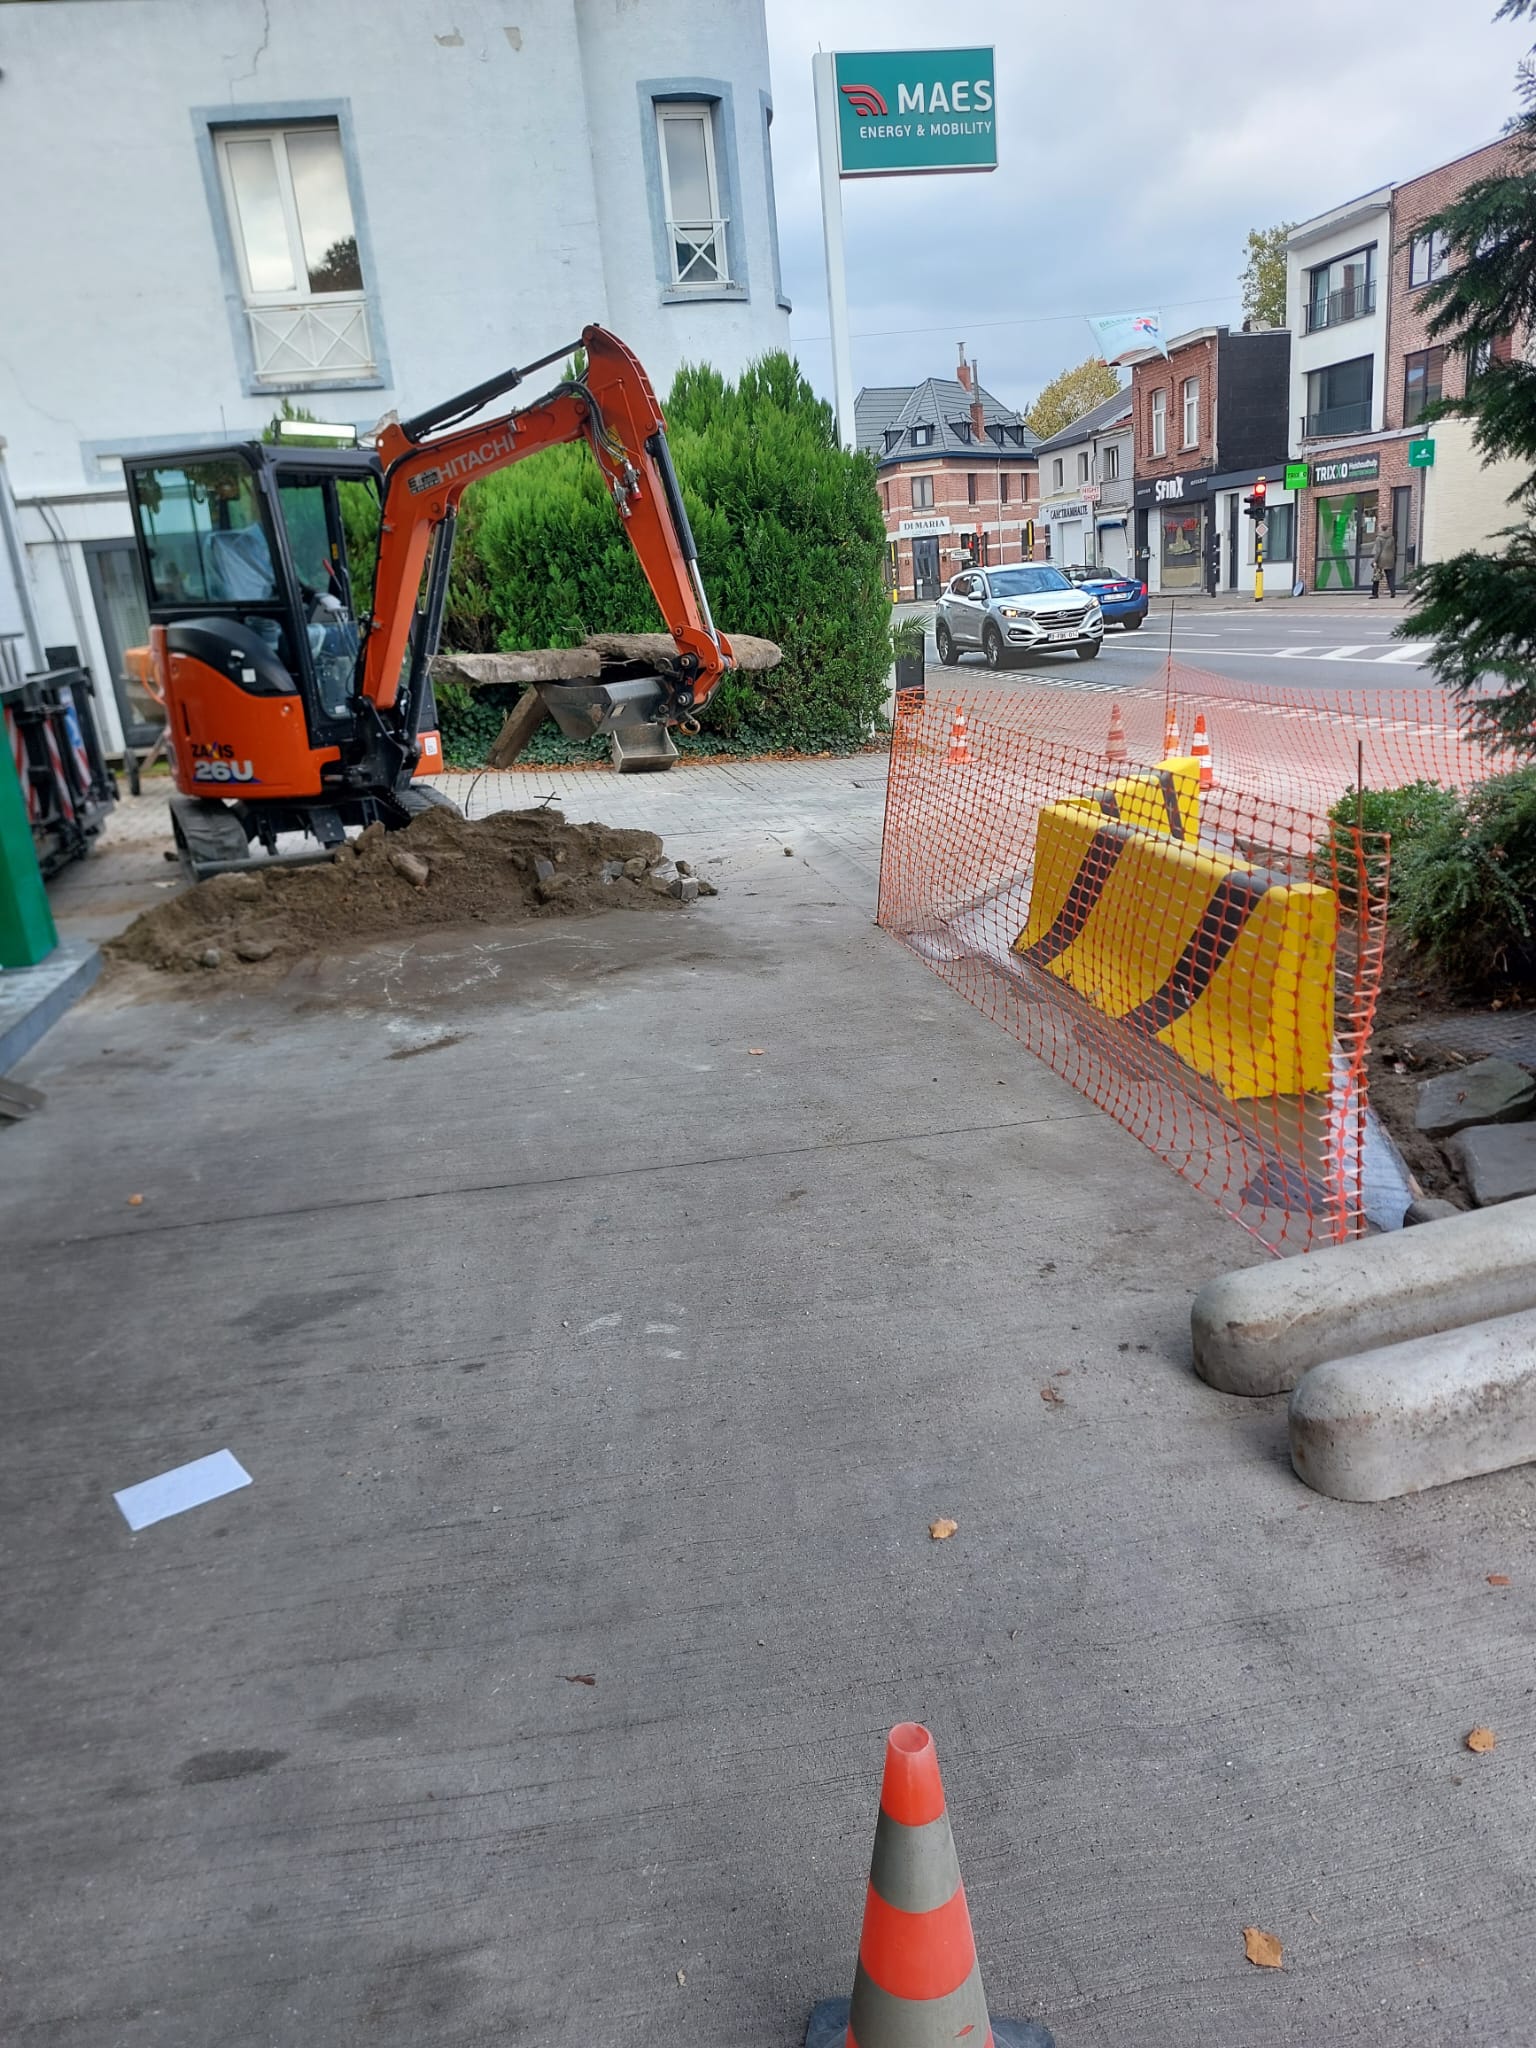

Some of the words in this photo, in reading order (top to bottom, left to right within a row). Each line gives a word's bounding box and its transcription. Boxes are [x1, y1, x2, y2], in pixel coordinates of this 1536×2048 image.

[898, 80, 992, 114] MAES
[859, 124, 911, 138] ENERGY
[916, 125, 925, 137] &
[930, 121, 992, 136] MOBILITY
[437, 434, 516, 482] HITACHI
[1315, 463, 1348, 481] TRIXXO
[1083, 486, 1099, 494] NIGHT
[915, 520, 945, 530] MARIA
[191, 741, 234, 758] ZAXIS
[194, 760, 254, 781] 26U
